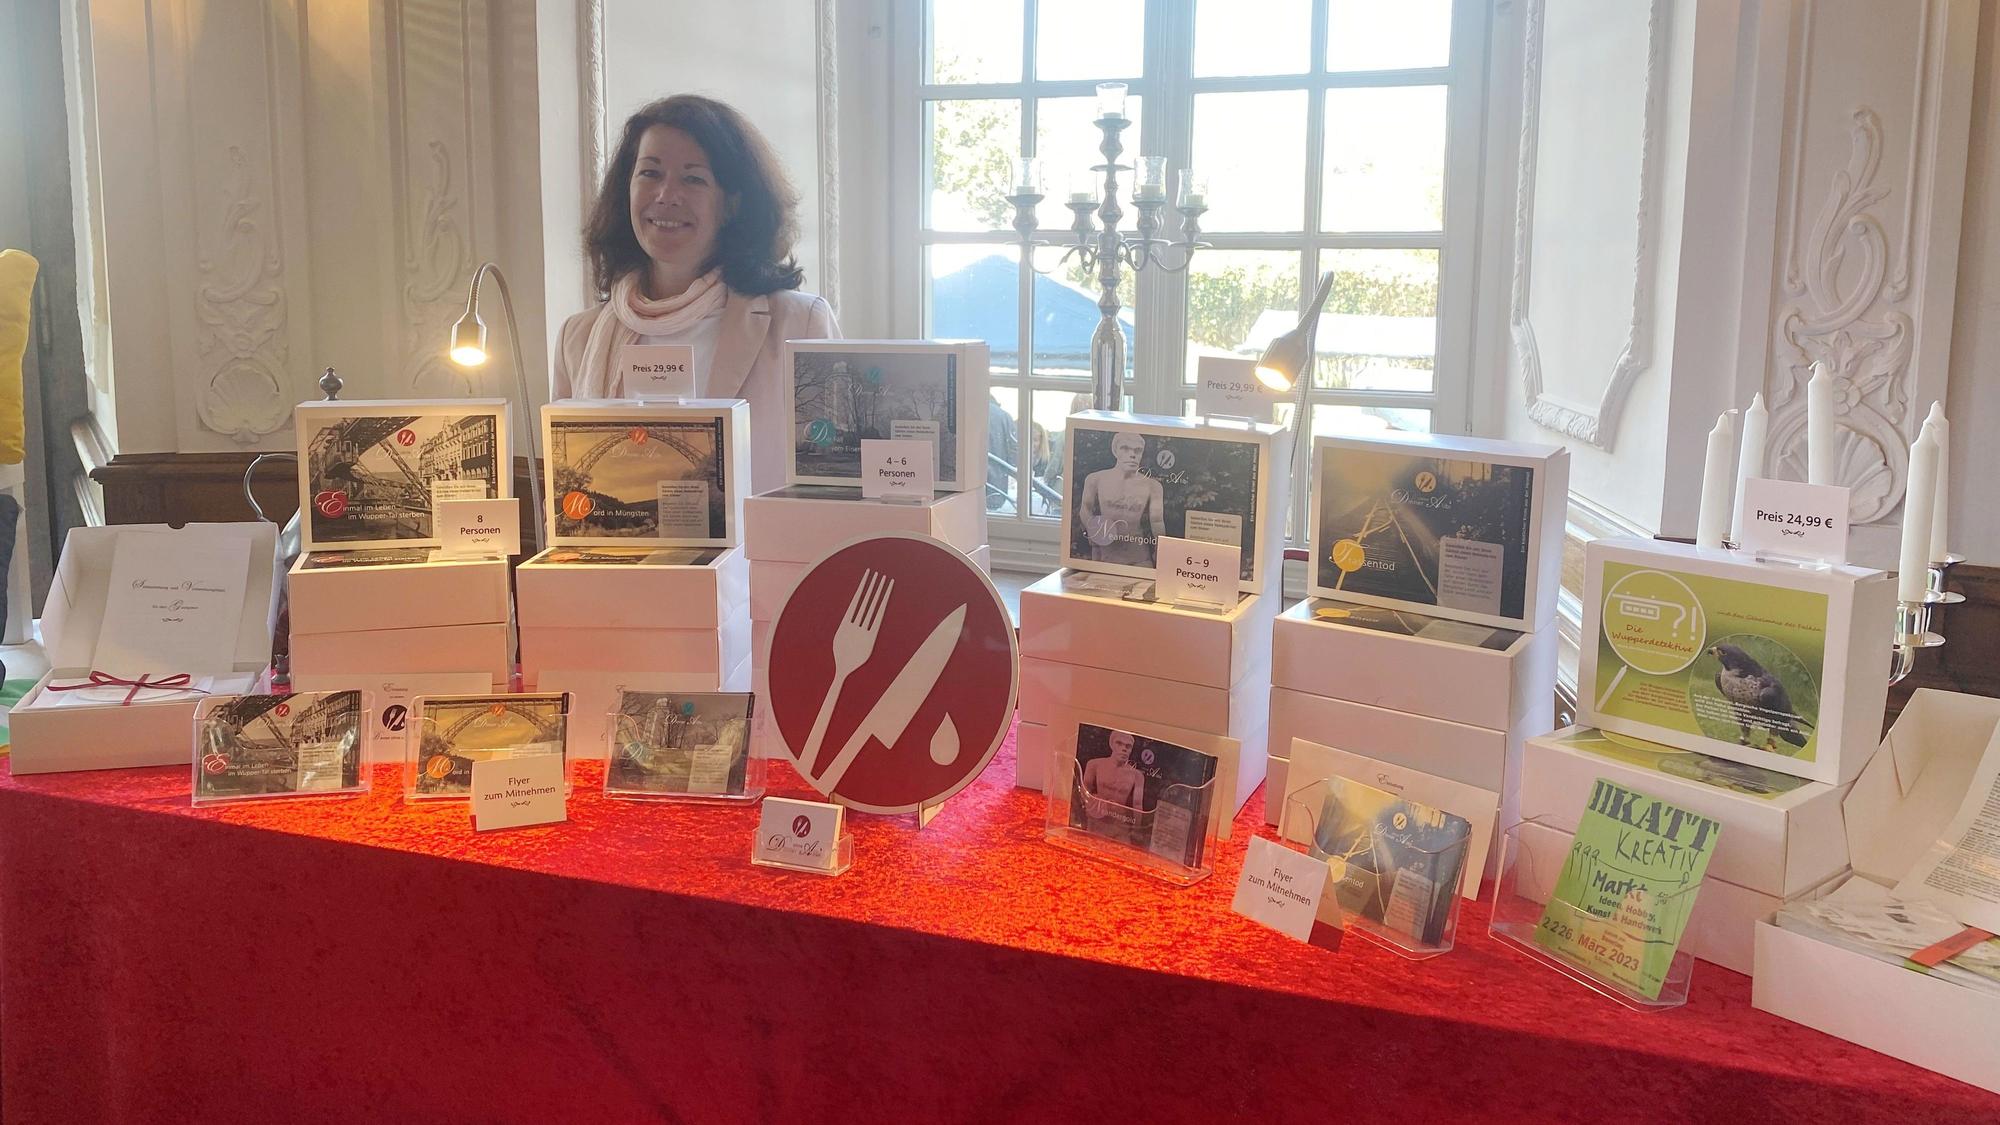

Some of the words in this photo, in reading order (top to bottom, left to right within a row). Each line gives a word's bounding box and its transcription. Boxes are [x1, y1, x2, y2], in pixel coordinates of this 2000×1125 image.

[632, 364, 652, 373] Preis
[654, 364, 677, 374] 29,99
[678, 364, 684, 372] €
[1207, 380, 1228, 391] Preis
[1230, 382, 1256, 393] 29,99
[886, 457, 892, 466] 4
[901, 457, 908, 466] 6
[879, 468, 916, 479] Personen
[314, 490, 362, 514] Einmal
[477, 514, 484, 524] 8
[615, 508, 650, 518] Müngsten
[1756, 510, 1784, 524] Preis
[1786, 512, 1821, 528] 24,99
[1824, 518, 1833, 528] €
[460, 526, 501, 536] Personen
[1186, 556, 1193, 566] 6
[1202, 558, 1210, 568] 9
[1176, 568, 1219, 582] Personen
[1626, 624, 1644, 634] Die
[508, 776, 531, 787] Flyer
[484, 791, 504, 801] zum
[505, 785, 556, 799] Mitnehmen
[1616, 828, 1704, 872] KREATIV
[1273, 867, 1294, 883] Flyer
[1248, 874, 1265, 888] zum
[1266, 879, 1311, 906] Mitnehmen
[1578, 933, 1608, 957] März
[1609, 949, 1640, 972] 2023
